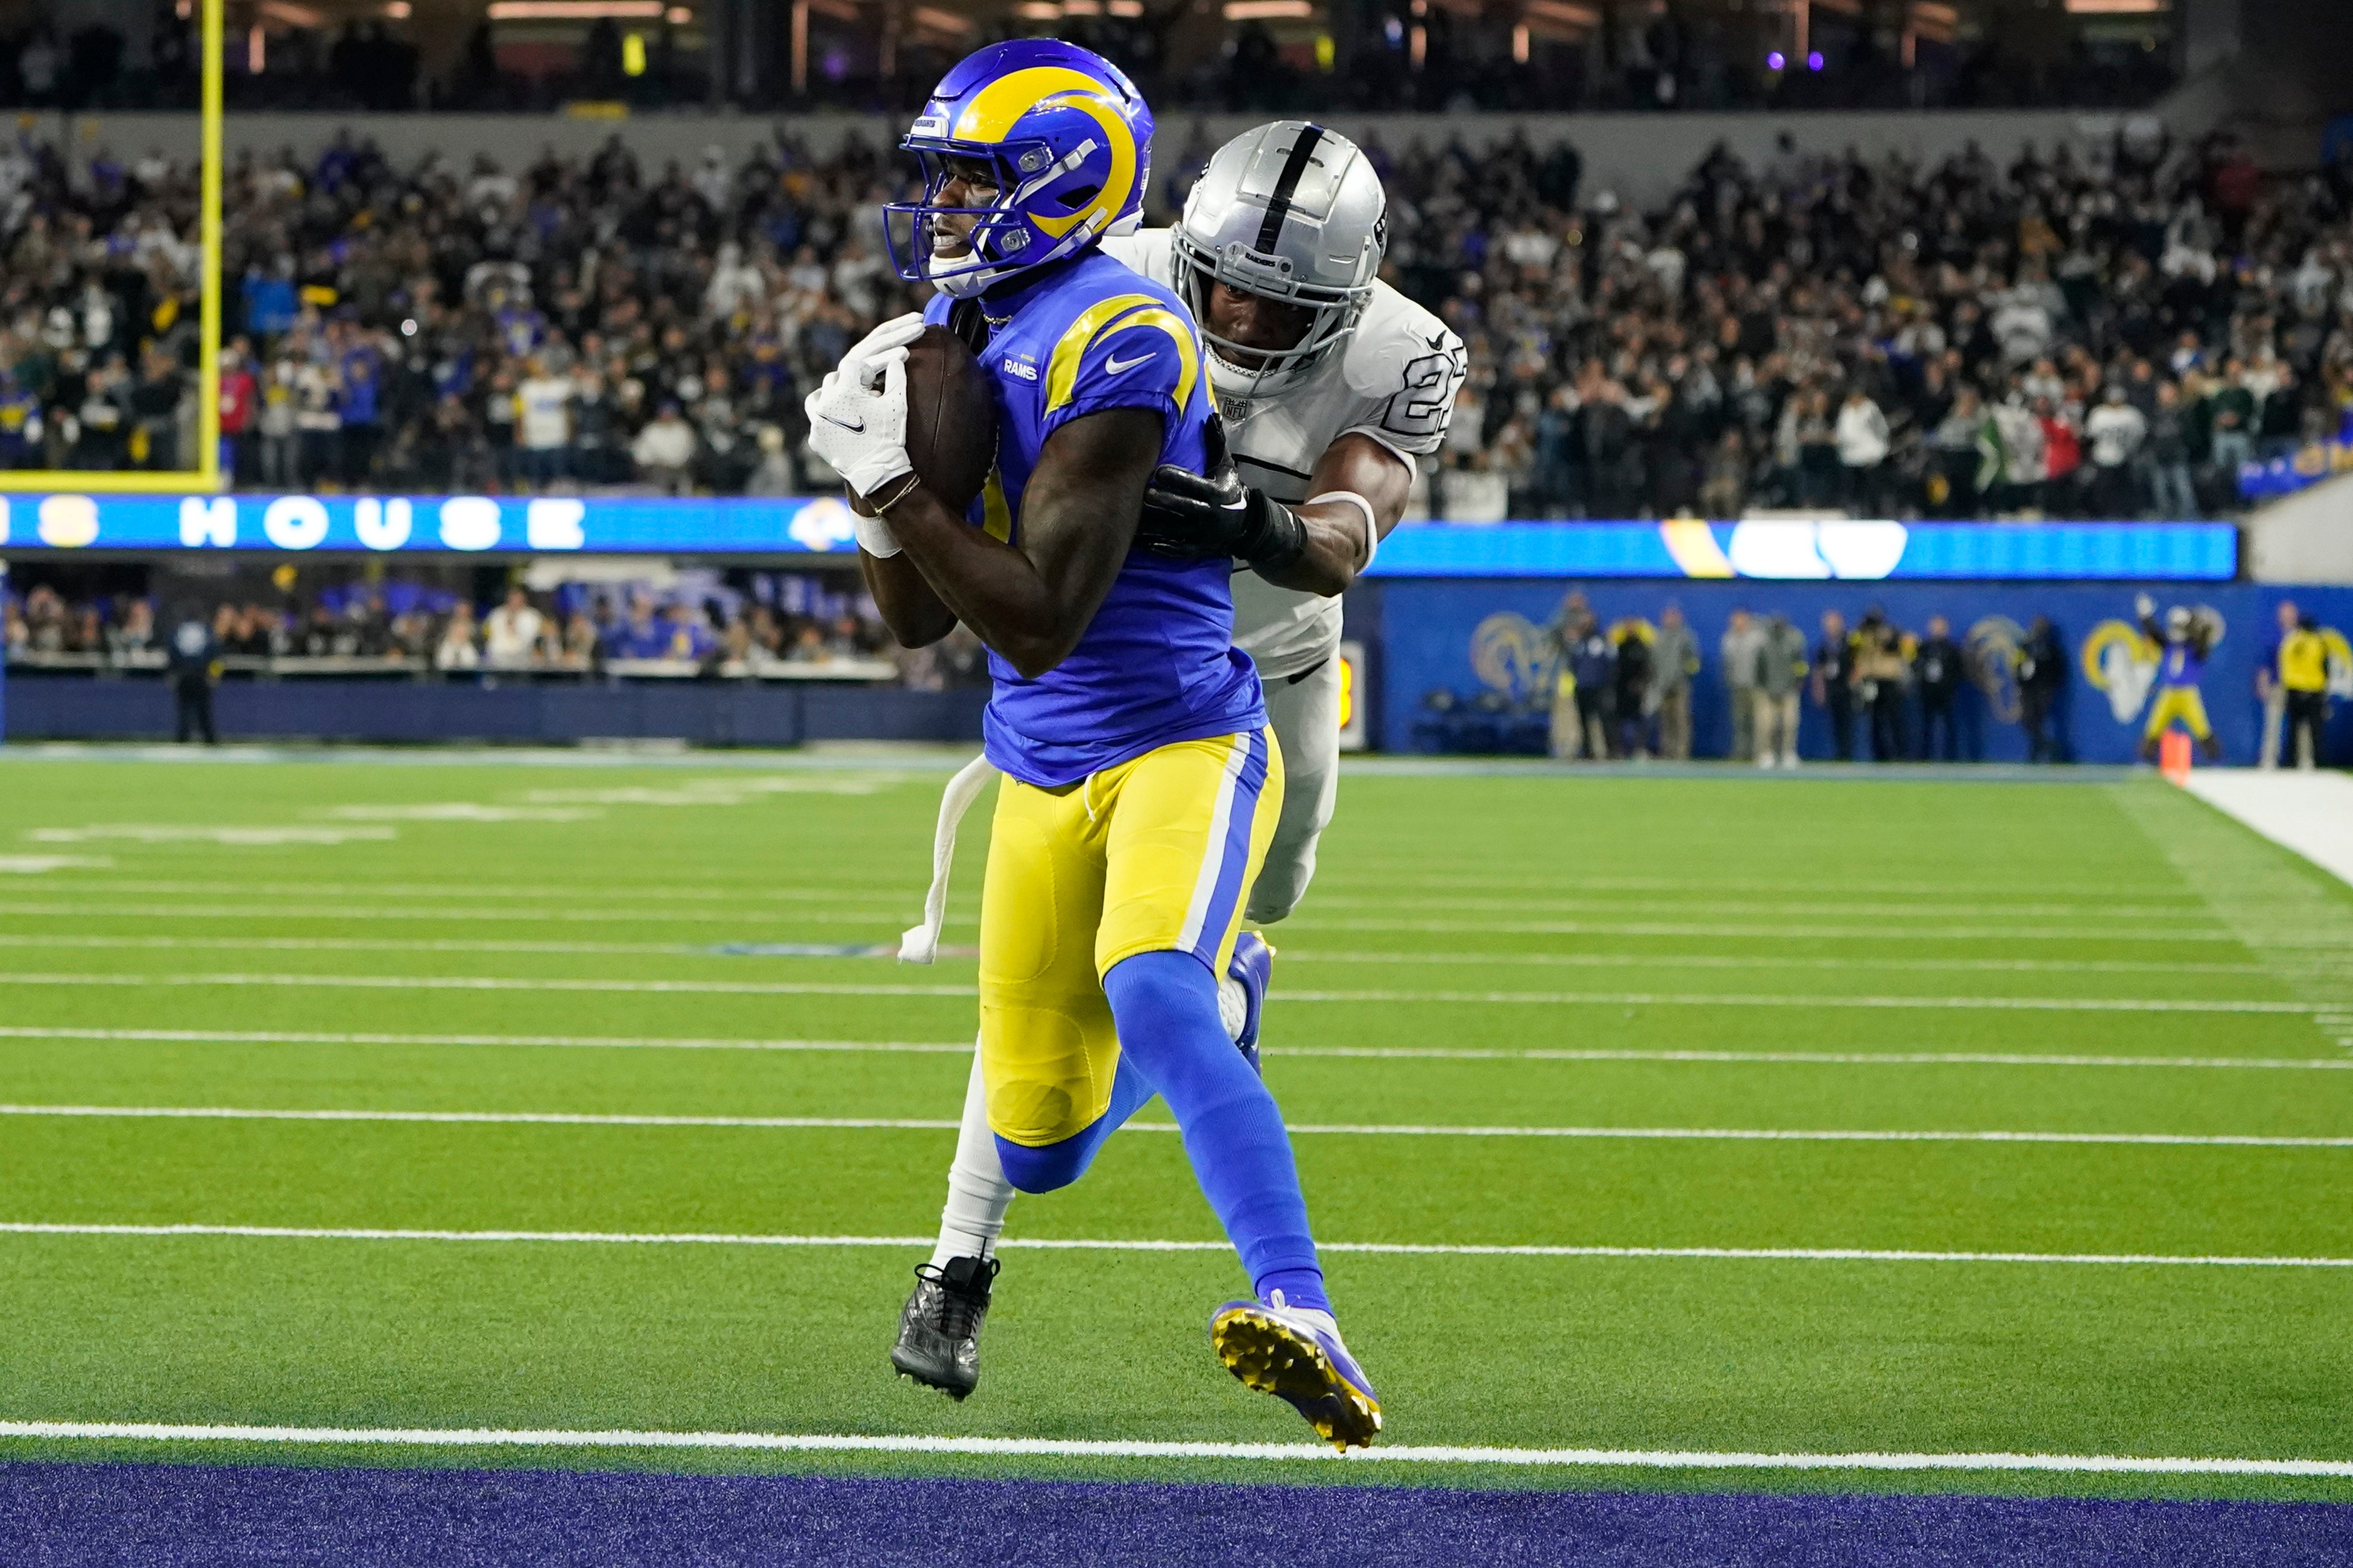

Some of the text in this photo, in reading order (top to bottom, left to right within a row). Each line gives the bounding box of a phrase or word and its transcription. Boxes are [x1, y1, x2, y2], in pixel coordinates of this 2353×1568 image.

[1245, 252, 1275, 267] RAIDERS
[1004, 359, 1038, 380] RAMS
[1226, 405, 1245, 419] NFL
[0, 494, 586, 551] S HOUSE
